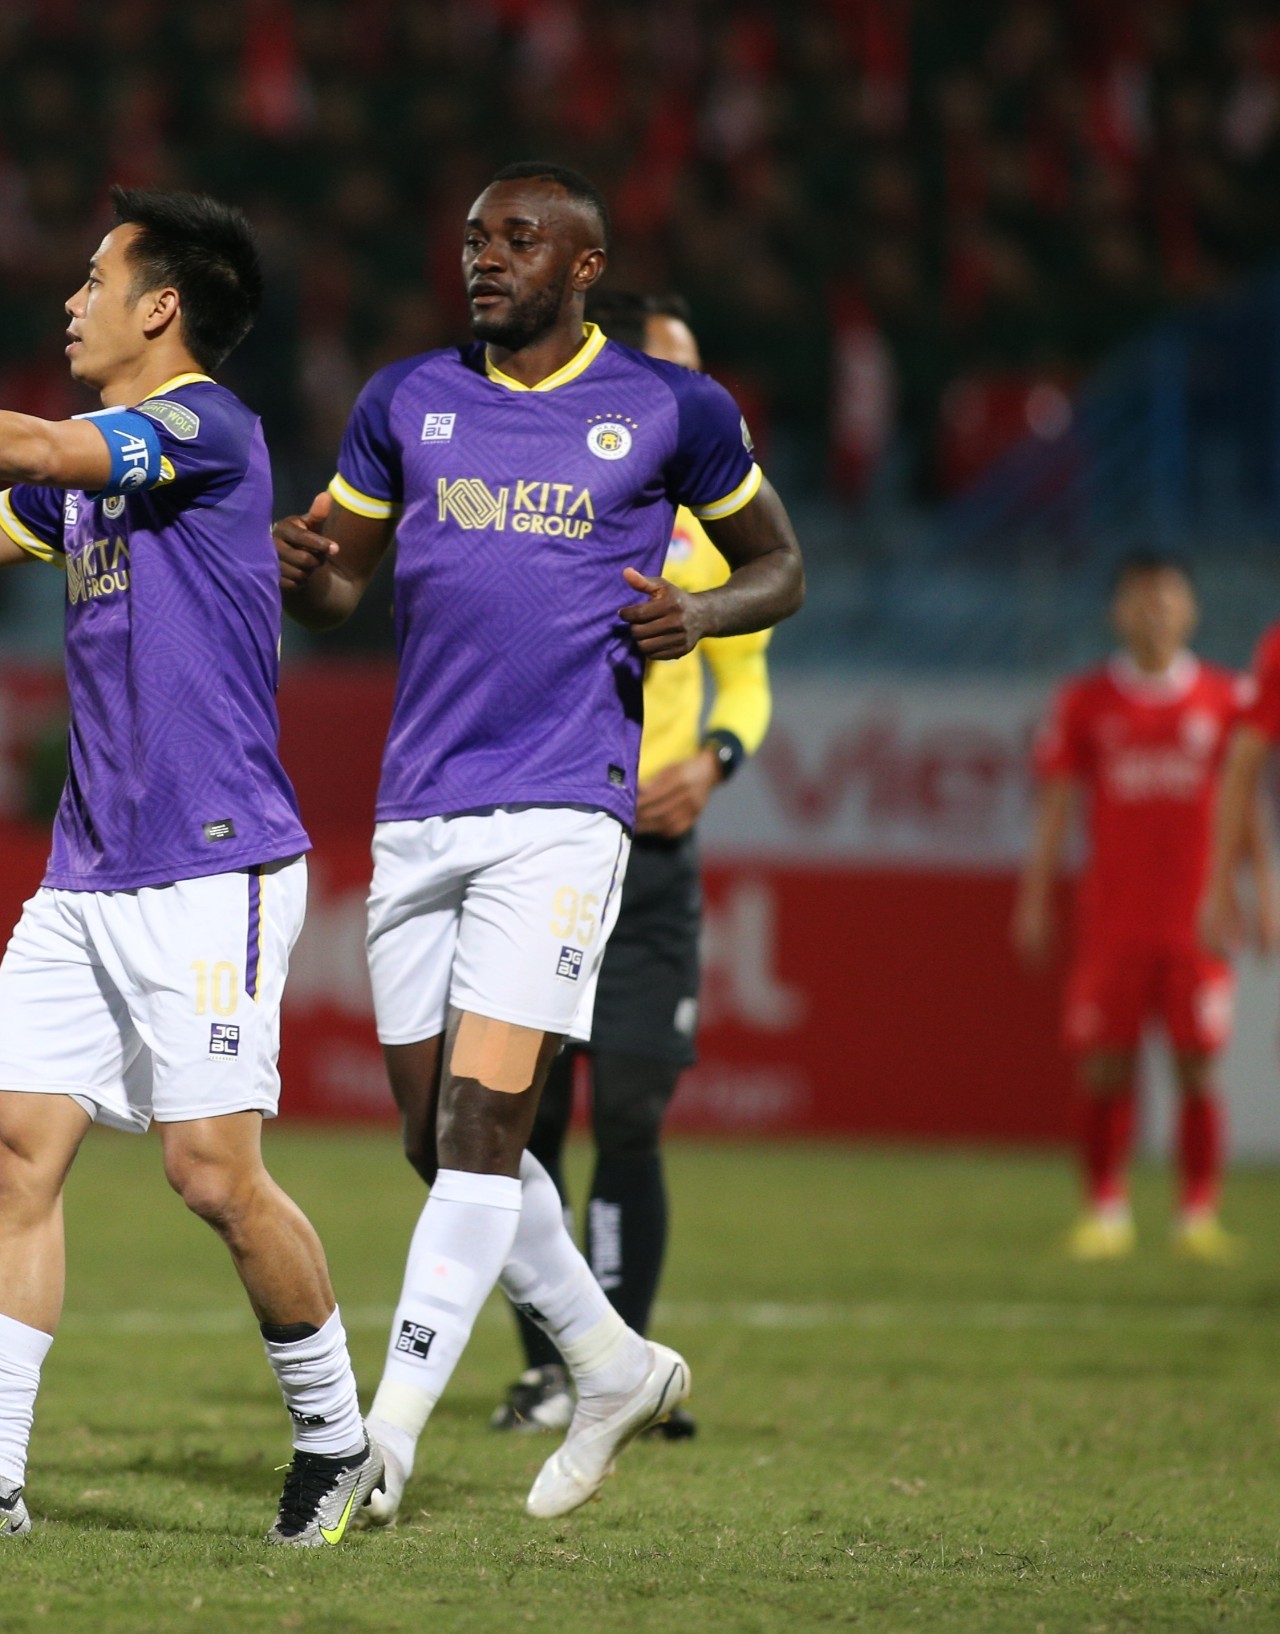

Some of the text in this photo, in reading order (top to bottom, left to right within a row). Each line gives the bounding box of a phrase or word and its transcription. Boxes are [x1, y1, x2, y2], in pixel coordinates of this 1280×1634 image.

[168, 410, 194, 433] WOLF
[513, 480, 595, 520] KITA
[512, 512, 593, 540] GROUP
[549, 886, 600, 946] 95
[190, 960, 239, 1017] 10
[212, 1025, 239, 1041] JG
[401, 1323, 433, 1344] JG
